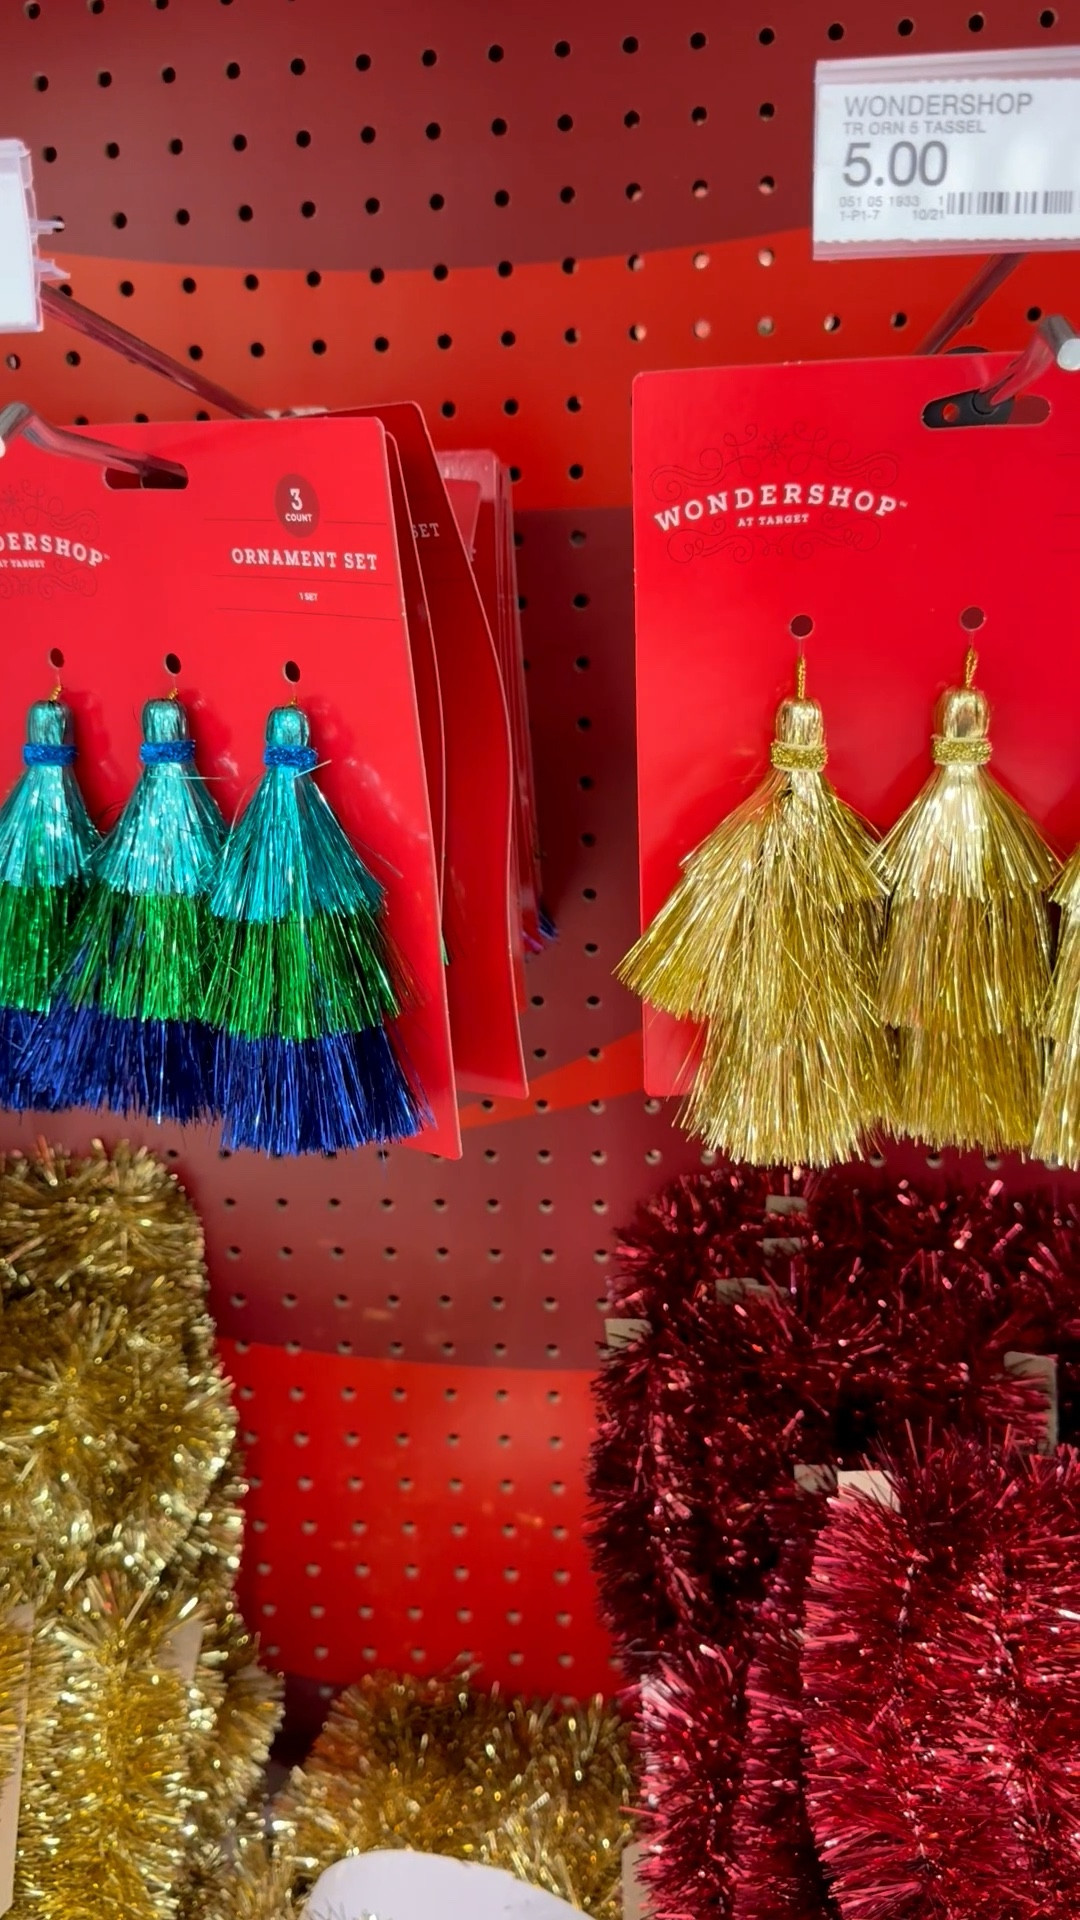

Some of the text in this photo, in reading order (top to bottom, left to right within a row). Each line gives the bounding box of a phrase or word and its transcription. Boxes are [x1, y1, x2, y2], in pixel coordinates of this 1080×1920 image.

[844, 93, 1032, 117] WONDERSHOP
[843, 120, 986, 135] TR ORN 5 TASSEL
[842, 141, 948, 187] 5.00
[289, 488, 303, 511] 3
[285, 513, 312, 522] COUNT
[737, 513, 809, 527] AT TARGET
[10, 559, 45, 568] TARGET
[231, 547, 377, 570] ORNAMENT SET
